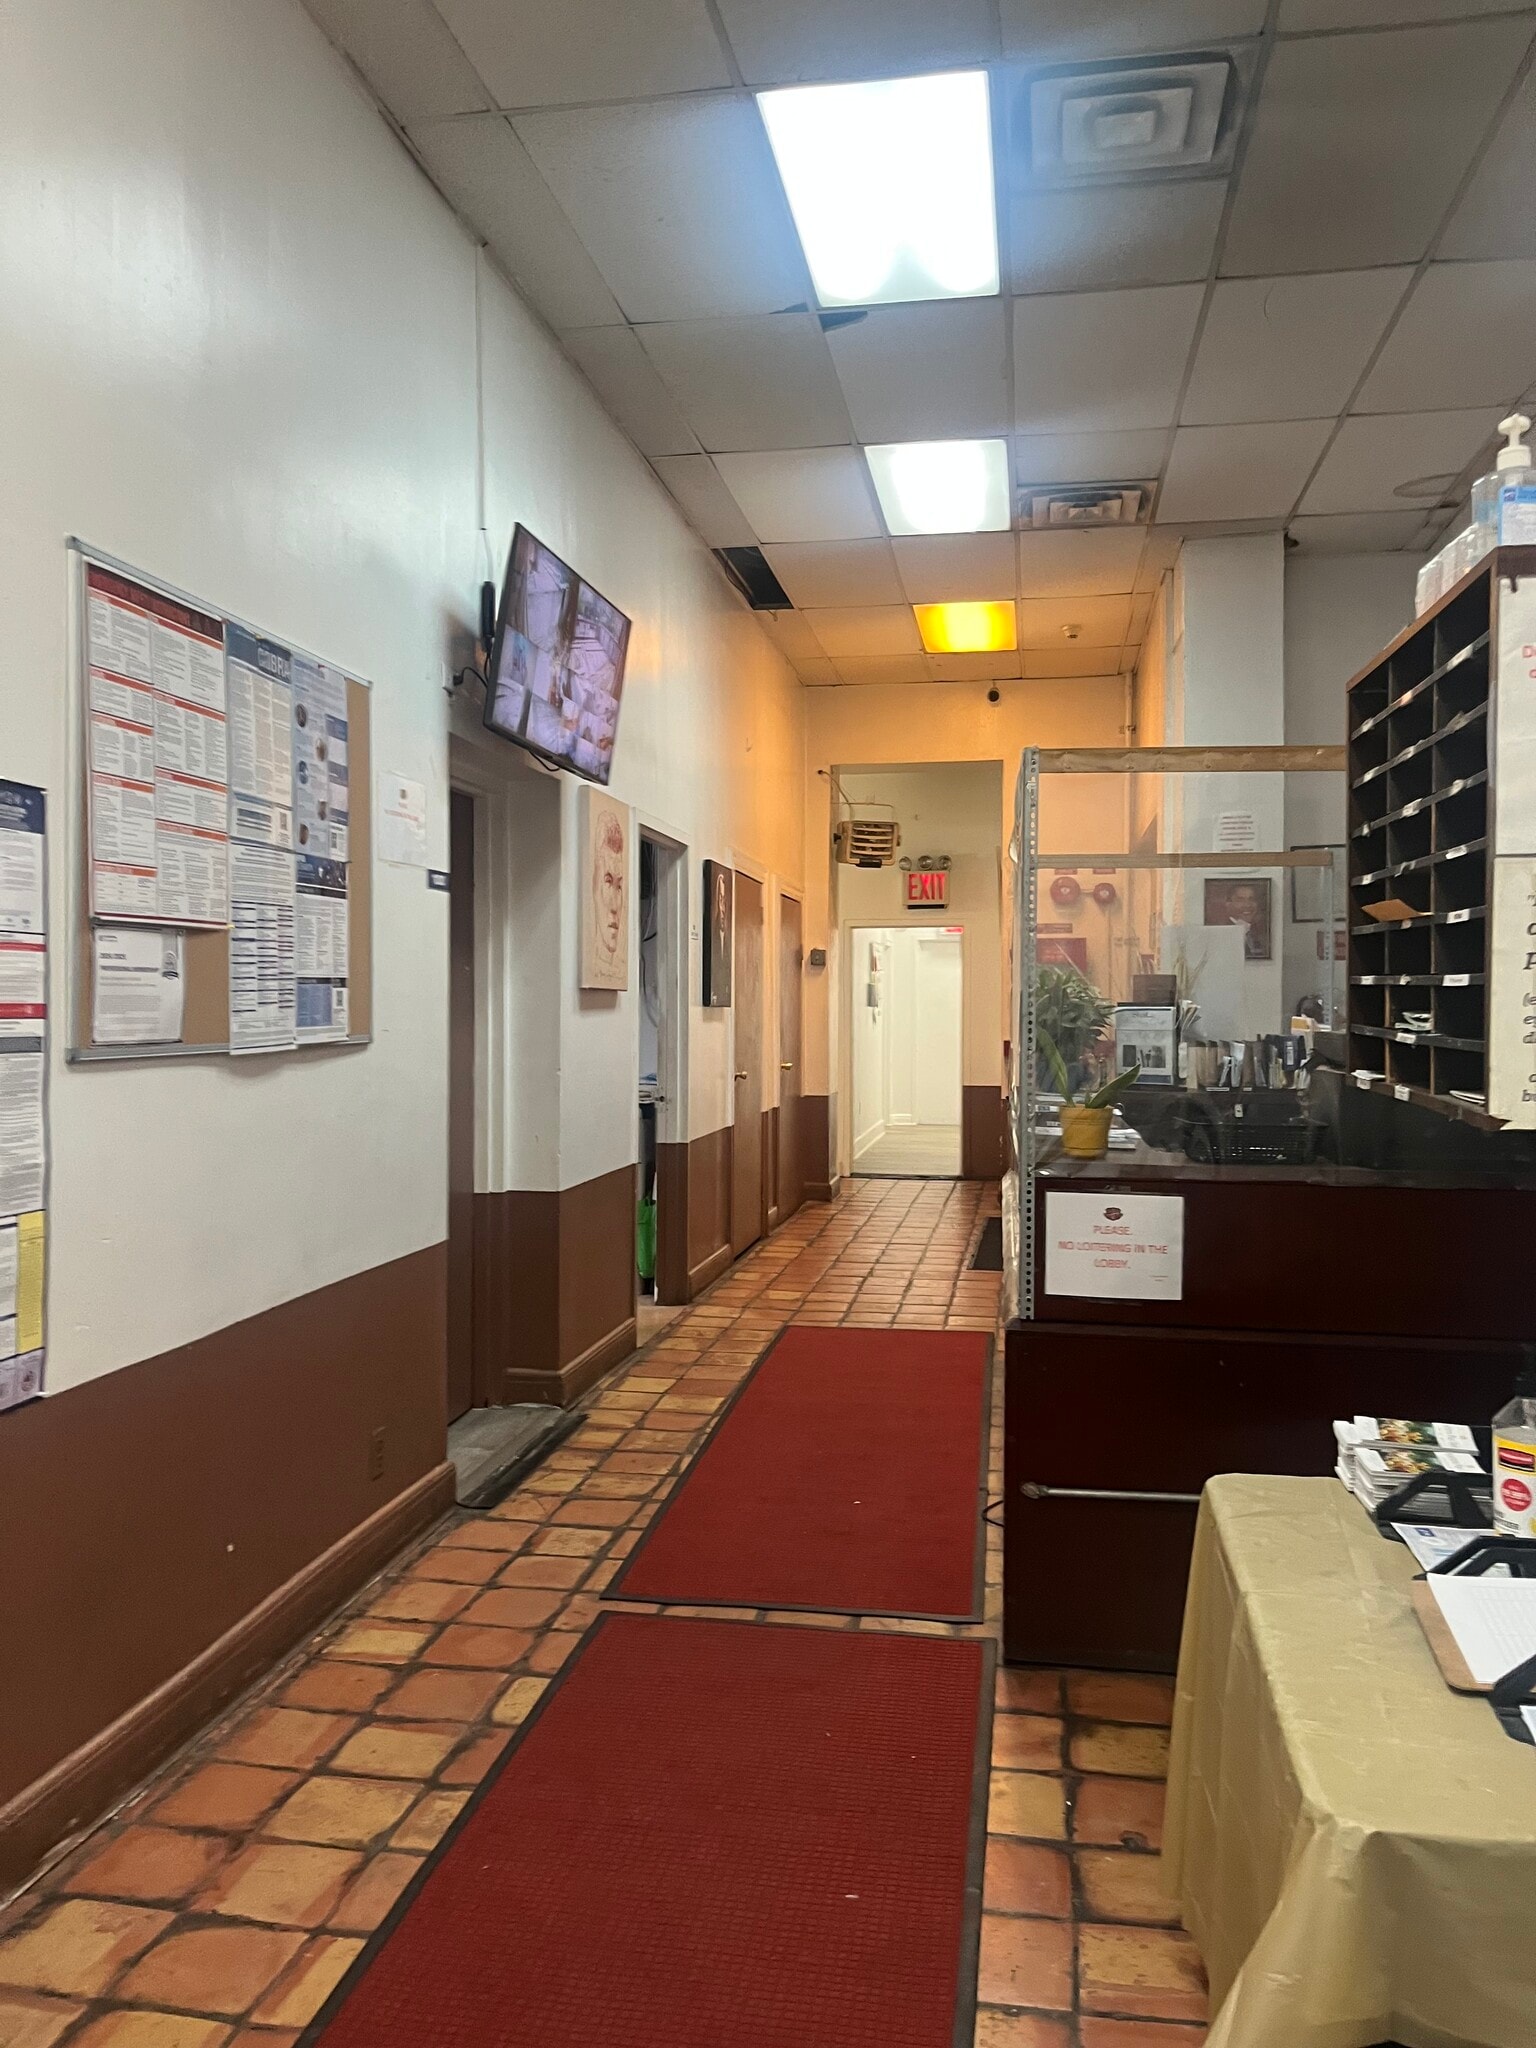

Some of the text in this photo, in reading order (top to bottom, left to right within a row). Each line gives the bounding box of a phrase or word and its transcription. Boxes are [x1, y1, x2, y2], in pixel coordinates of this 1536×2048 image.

[908, 872, 945, 900] EXIT
[1058, 1241, 1074, 1251] NO
[1134, 1244, 1146, 1254] IN
[1148, 1244, 1169, 1255] THE
